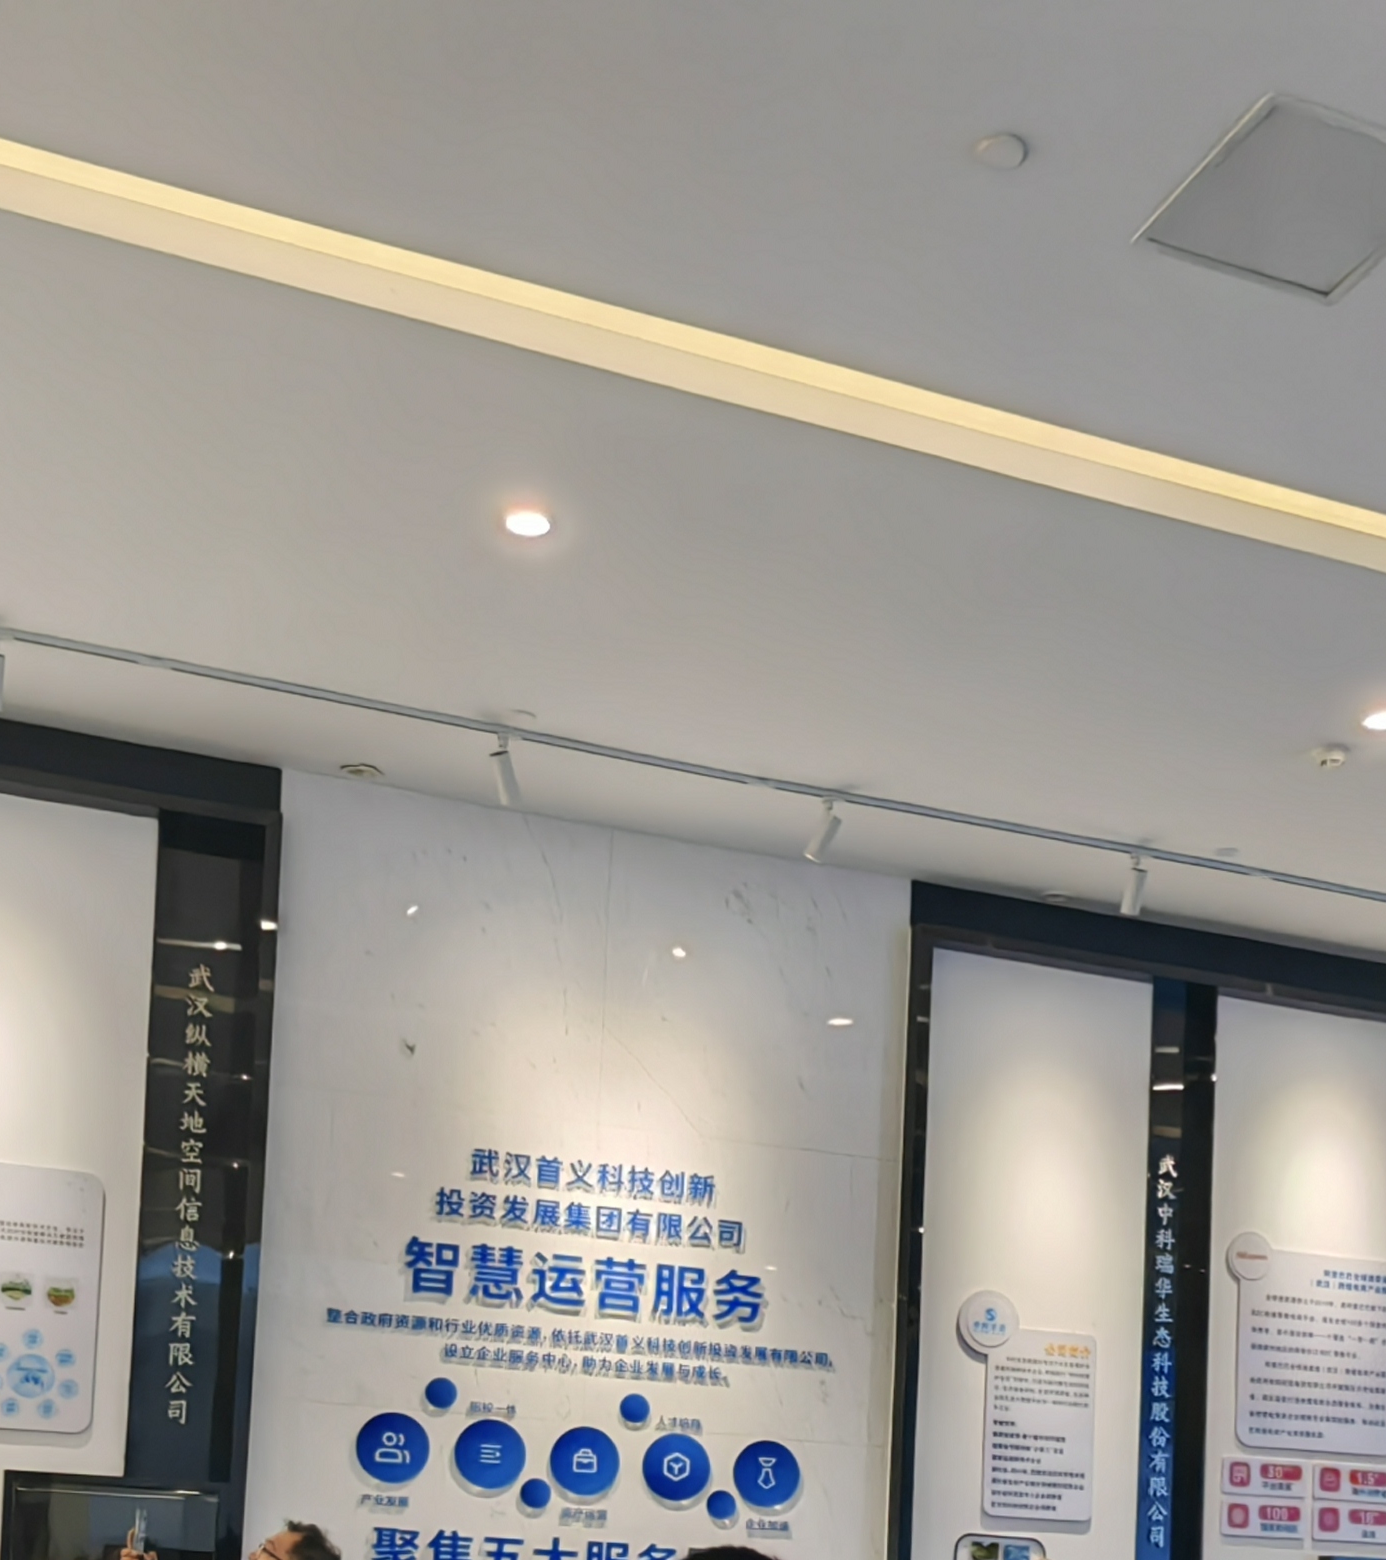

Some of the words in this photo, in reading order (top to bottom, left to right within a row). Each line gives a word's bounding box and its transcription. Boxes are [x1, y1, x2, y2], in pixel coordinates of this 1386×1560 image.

[164, 963, 215, 1425] 武汉纵横天地空间信息技术有限公司
[435, 1187, 743, 1248] 投资发展集团有限公司
[471, 1147, 716, 1204] 武汉首义科技创新
[404, 1237, 765, 1323] 智慧运营服务
[1147, 1154, 1178, 1549] 武汉中科瑞华生态科技股份有限公司
